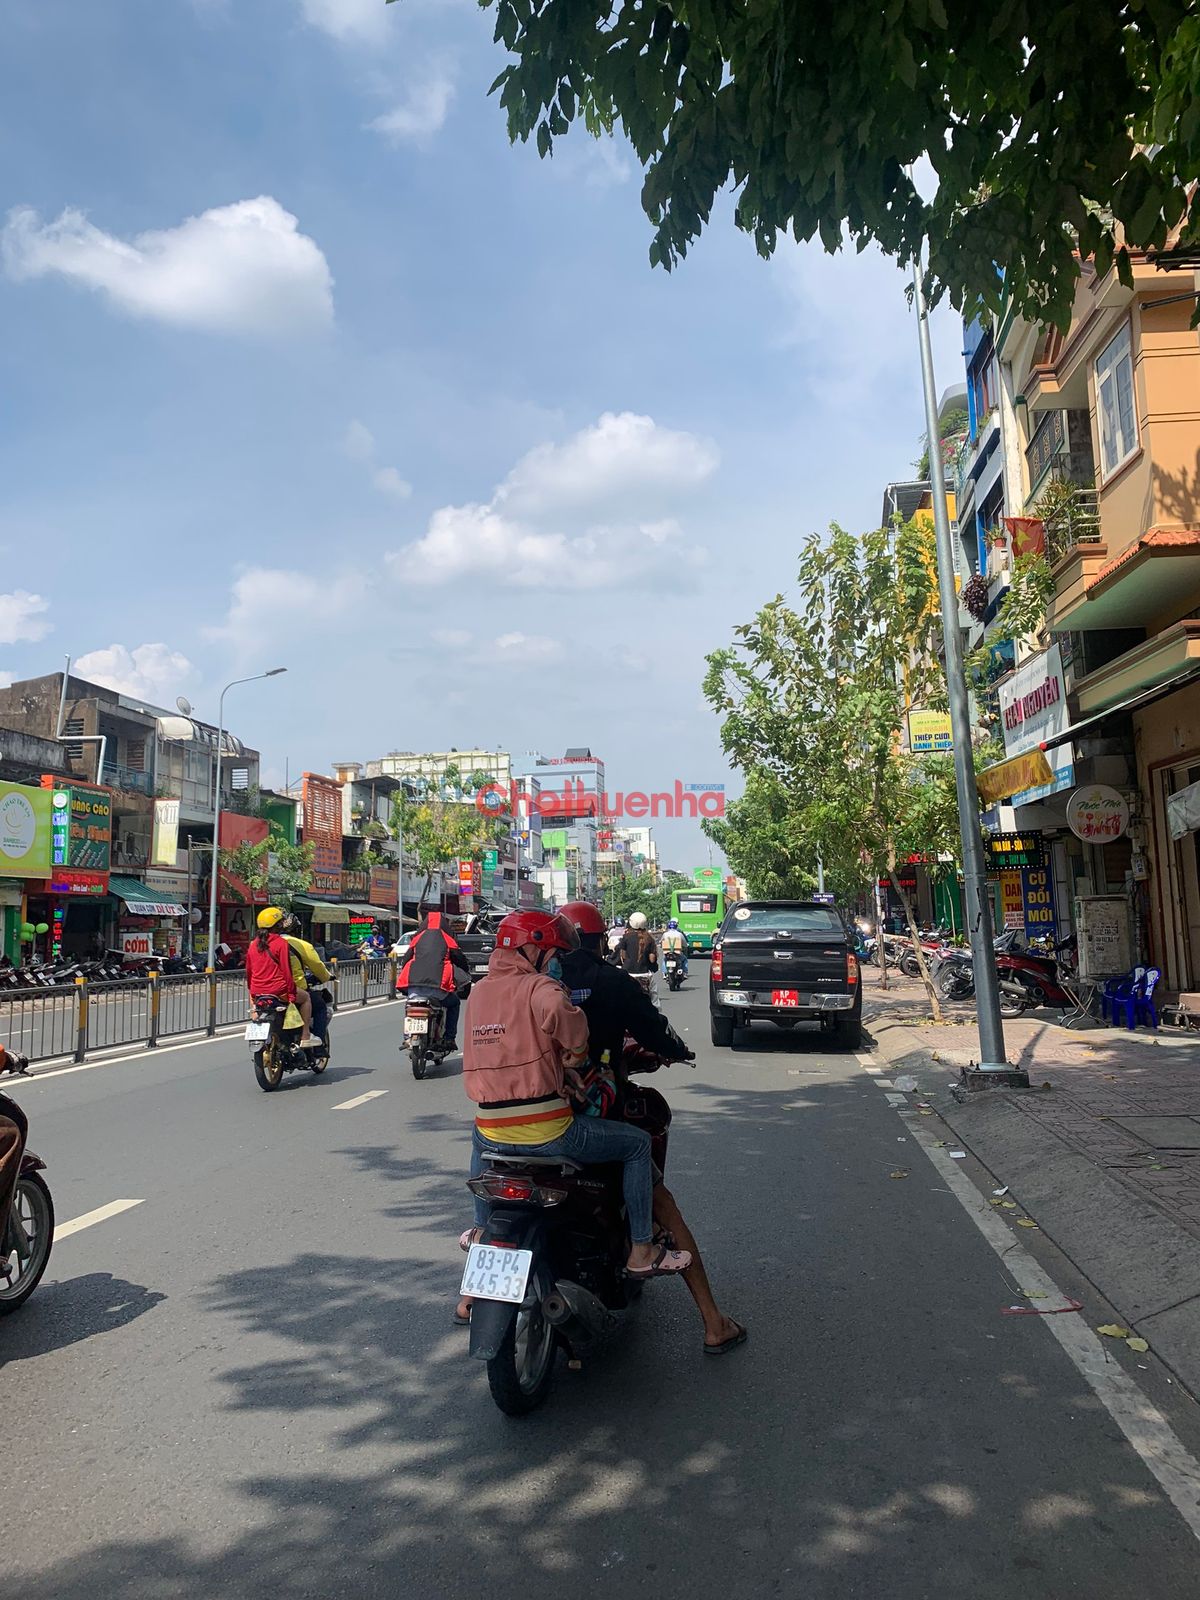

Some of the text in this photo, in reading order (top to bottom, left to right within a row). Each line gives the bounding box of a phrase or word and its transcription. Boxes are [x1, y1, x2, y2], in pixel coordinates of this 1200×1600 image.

[1005, 884, 1022, 897] DAN
[1027, 886, 1050, 904] ĐỔI
[1027, 907, 1053, 922] MỚI
[476, 1249, 520, 1274] 83-P4
